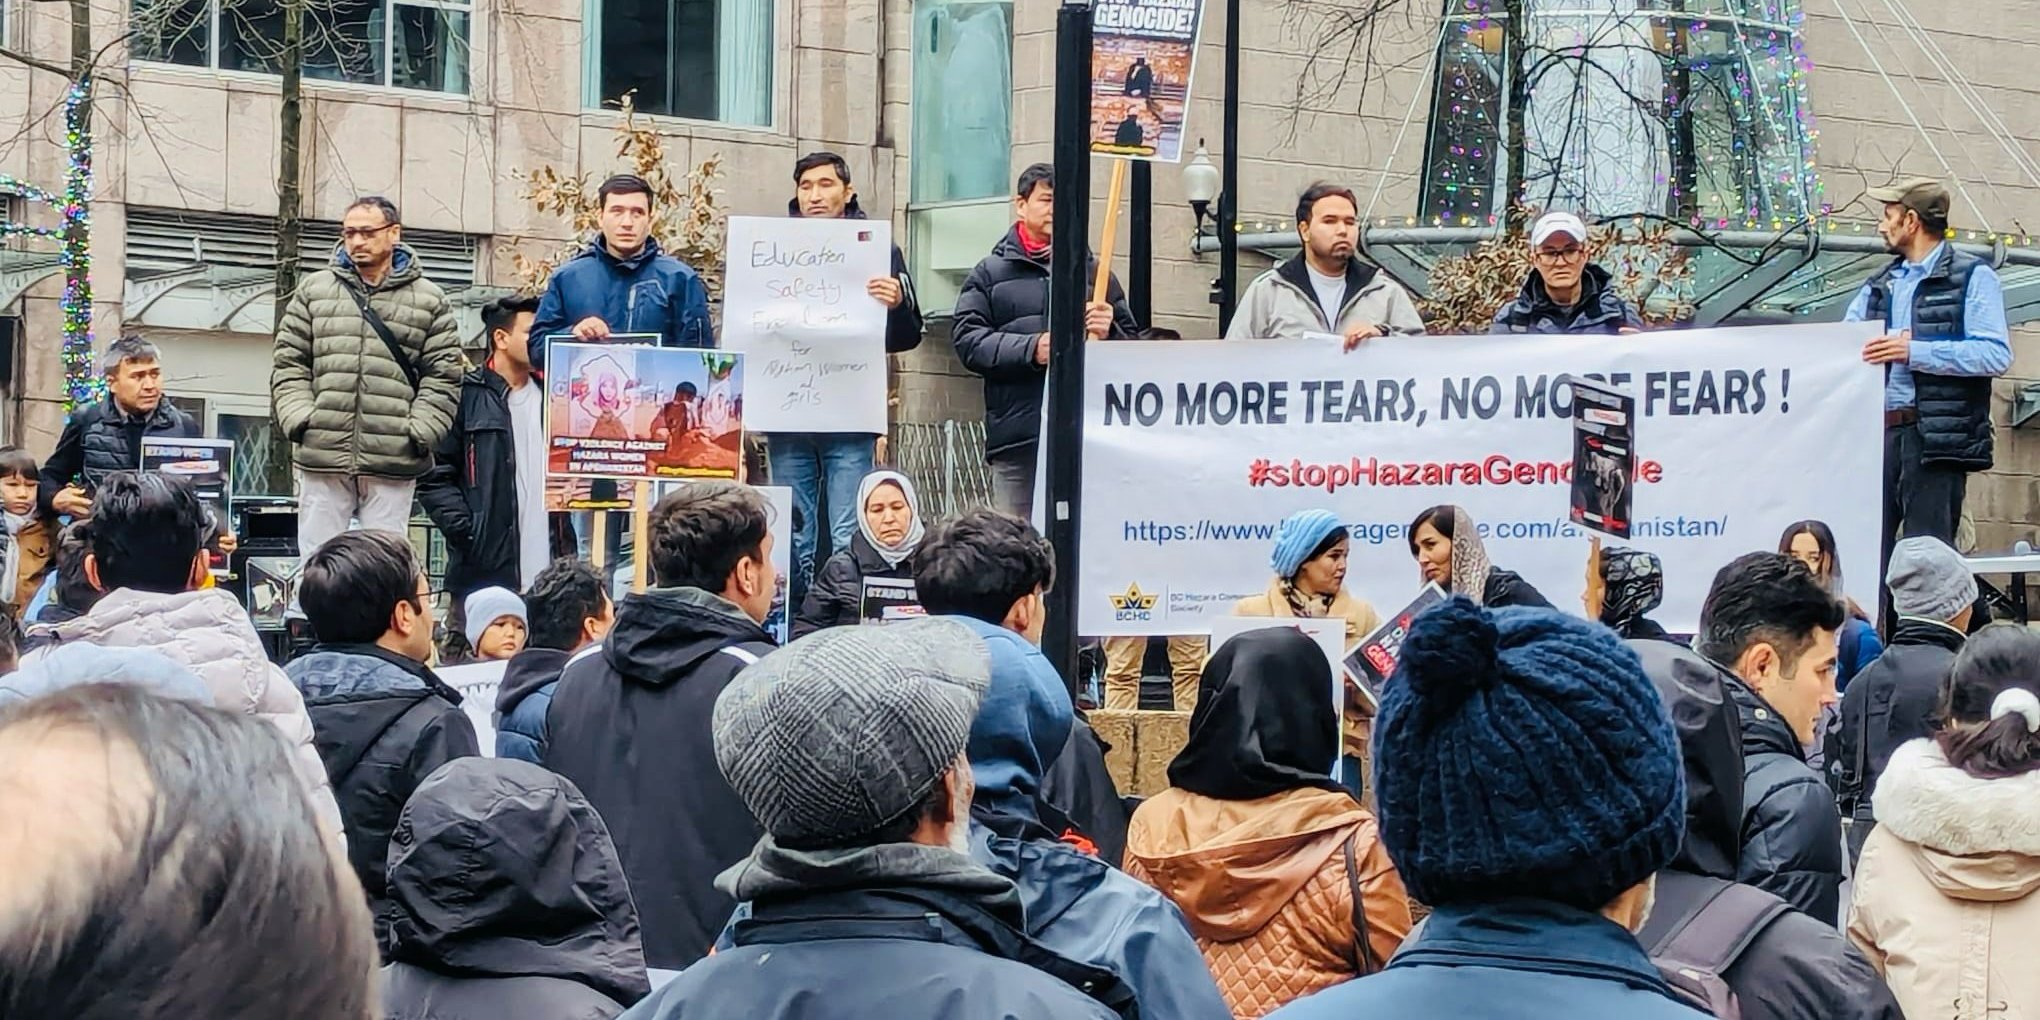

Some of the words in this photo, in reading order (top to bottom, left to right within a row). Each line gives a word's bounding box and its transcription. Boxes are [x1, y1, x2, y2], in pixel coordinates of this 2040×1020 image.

[1094, 4, 1194, 33] GENOCIDE!
[752, 241, 845, 267] Education
[767, 278, 841, 305] Safety
[1104, 382, 1163, 427] NO
[1175, 381, 1288, 425] MORE
[1300, 380, 1427, 427] TEARS,
[1441, 376, 1500, 420] NO
[1645, 369, 1766, 417] FEARS
[1248, 455, 1663, 494] #stopHazaraGenoe
